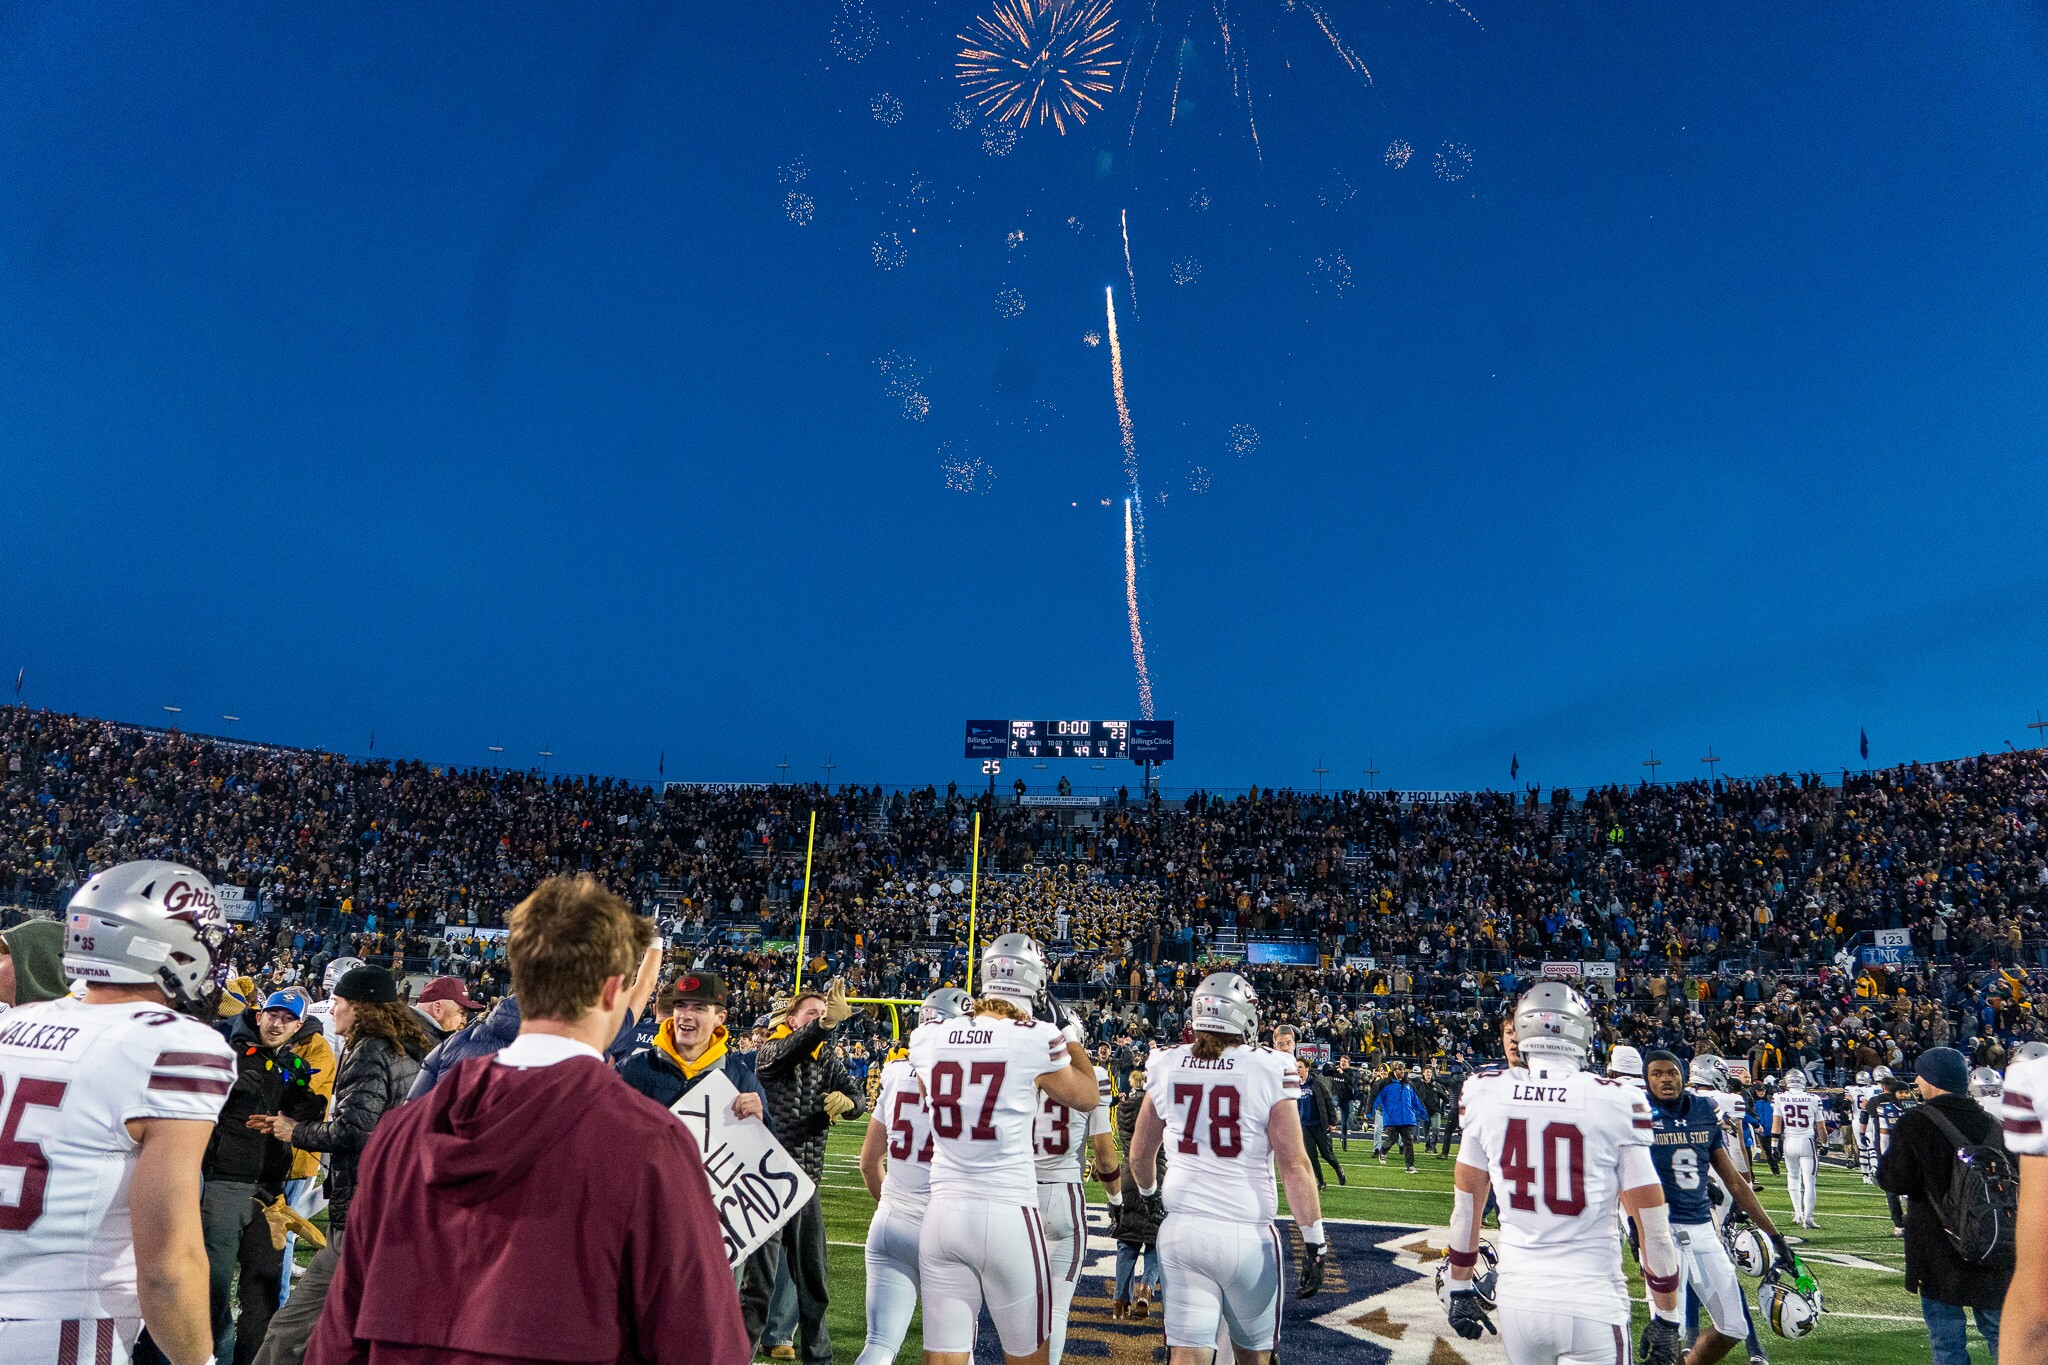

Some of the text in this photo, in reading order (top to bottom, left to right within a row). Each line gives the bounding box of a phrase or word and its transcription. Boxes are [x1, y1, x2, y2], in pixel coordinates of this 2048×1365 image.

[1058, 721, 1089, 734] 0:00
[1012, 728, 1027, 738] 48
[1111, 728, 1126, 739] 23
[967, 736, 988, 745] Billings
[1011, 741, 1017, 749] 2
[1131, 738, 1153, 746] Billings
[1055, 746, 1062, 756] 7
[1120, 742, 1125, 750] 2
[1030, 747, 1036, 756] 4
[1074, 747, 1089, 756] 49
[1100, 747, 1106, 756] 4
[982, 761, 1000, 773] 25
[220, 890, 238, 899] 117
[81, 937, 95, 950] 35
[1881, 936, 1903, 944] 123
[76, 967, 111, 977] MONTANA
[1211, 1007, 1219, 1015] 78
[1551, 1025, 1560, 1034] 40
[948, 1031, 993, 1044] OLSON
[1513, 1085, 1567, 1102] LENTZ
[931, 1061, 1007, 1141] 87
[1173, 1083, 1243, 1158] 78
[1784, 1104, 1810, 1128] 25
[1690, 1131, 1709, 1144] STATE
[0, 1072, 72, 1233] 5
[1500, 1117, 1588, 1218] 40
[1671, 1149, 1701, 1190] 8
